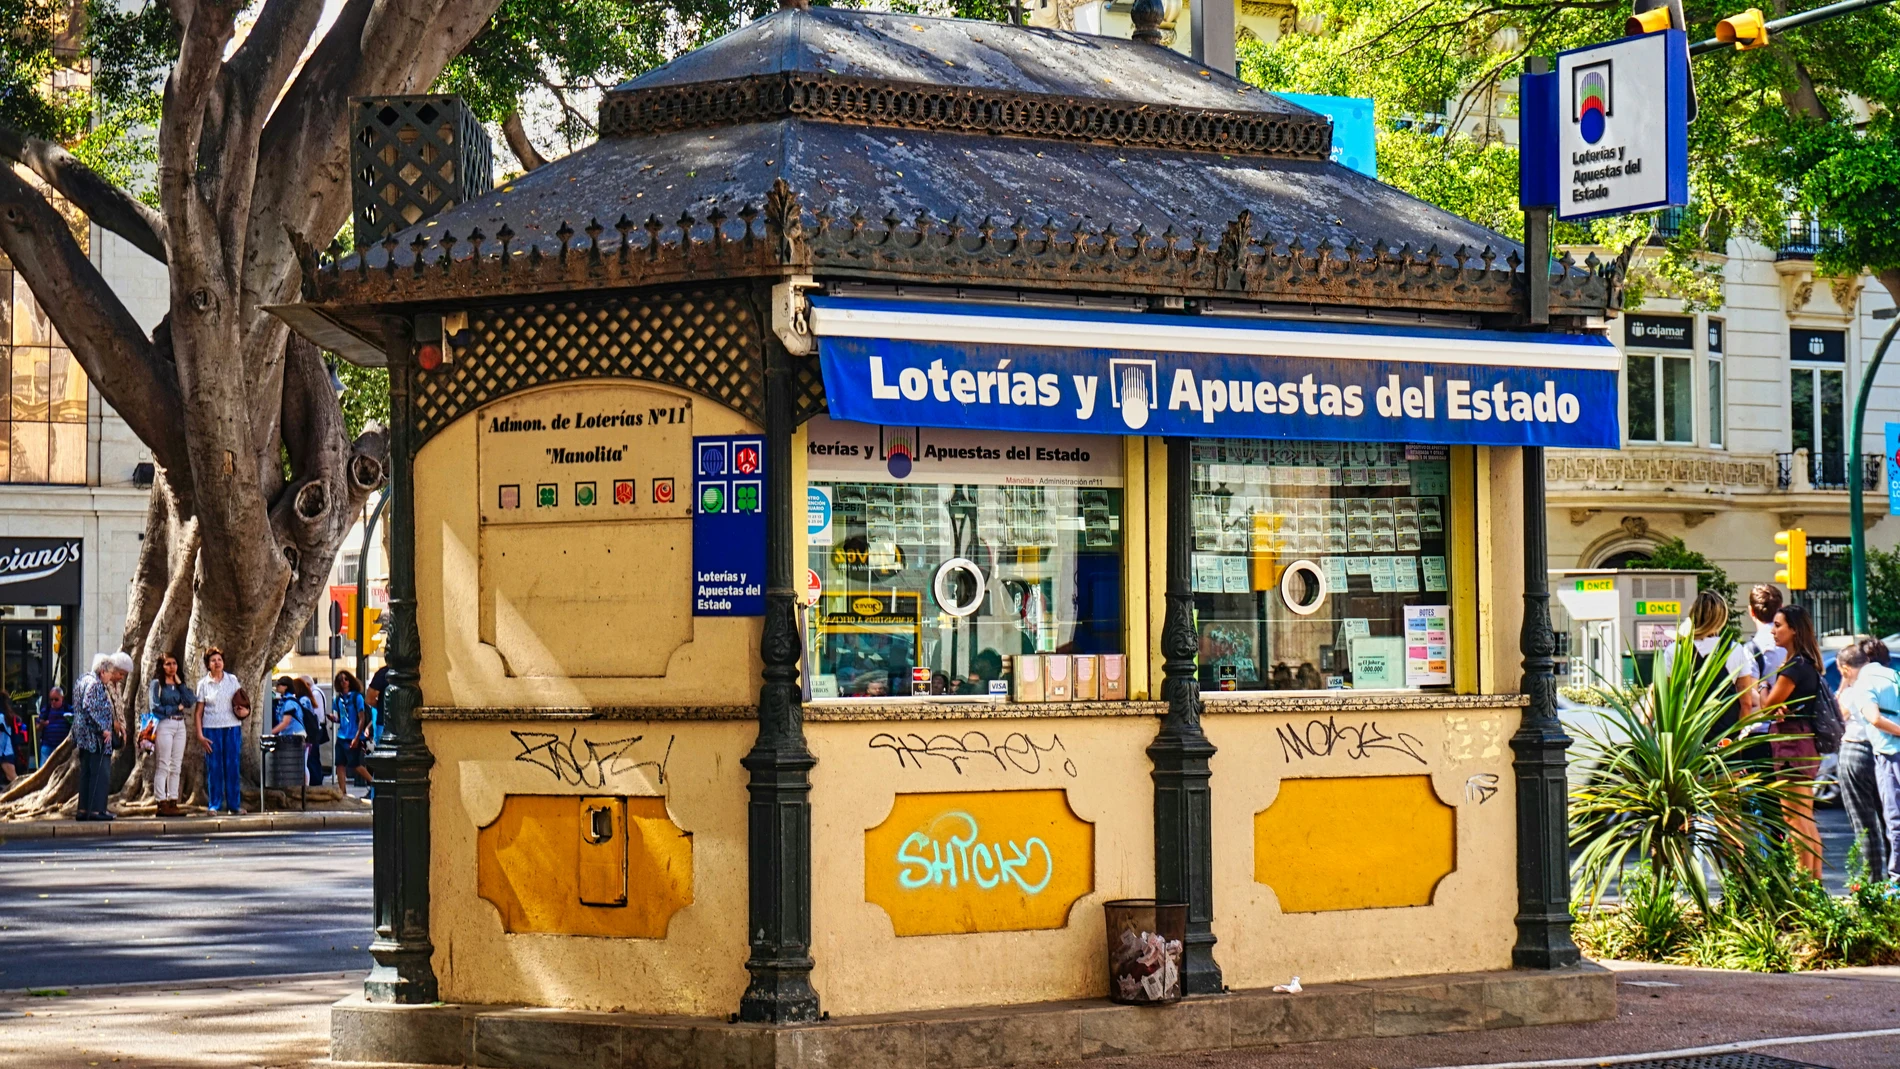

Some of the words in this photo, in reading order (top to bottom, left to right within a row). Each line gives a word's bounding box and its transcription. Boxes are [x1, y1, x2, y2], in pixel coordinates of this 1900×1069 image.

[1572, 145, 1616, 166] Loterías
[1618, 146, 1626, 160] y
[1572, 164, 1622, 187] Apuestas
[1625, 158, 1641, 175] del
[1572, 184, 1609, 202] Estado
[1646, 324, 1685, 338] cajamar
[869, 356, 1060, 407] Loterías
[1073, 375, 1098, 420] y
[1168, 369, 1364, 424] Apuestas
[1376, 374, 1436, 419] del
[1447, 379, 1580, 424] Estado
[488, 416, 547, 433] Admon.
[551, 413, 571, 429] de
[575, 410, 643, 429] Loterías
[546, 445, 628, 464] "Manolita"
[864, 445, 874, 459] y
[924, 444, 1000, 461] Apuestas
[1006, 446, 1030, 460] del
[1036, 447, 1090, 462] Estado
[1005, 476, 1034, 485] Manolita
[1039, 477, 1088, 486] Administración
[698, 570, 738, 582] Loterías
[740, 573, 747, 585] y
[698, 585, 744, 599] Apuestas
[745, 584, 761, 596] del
[1587, 581, 1611, 590] ONCE
[697, 598, 732, 610] Estado
[1650, 604, 1677, 613] ONCE
[1418, 608, 1435, 617] BOTES
[991, 682, 1007, 690] VISA
[1329, 676, 1342, 686] VISA
